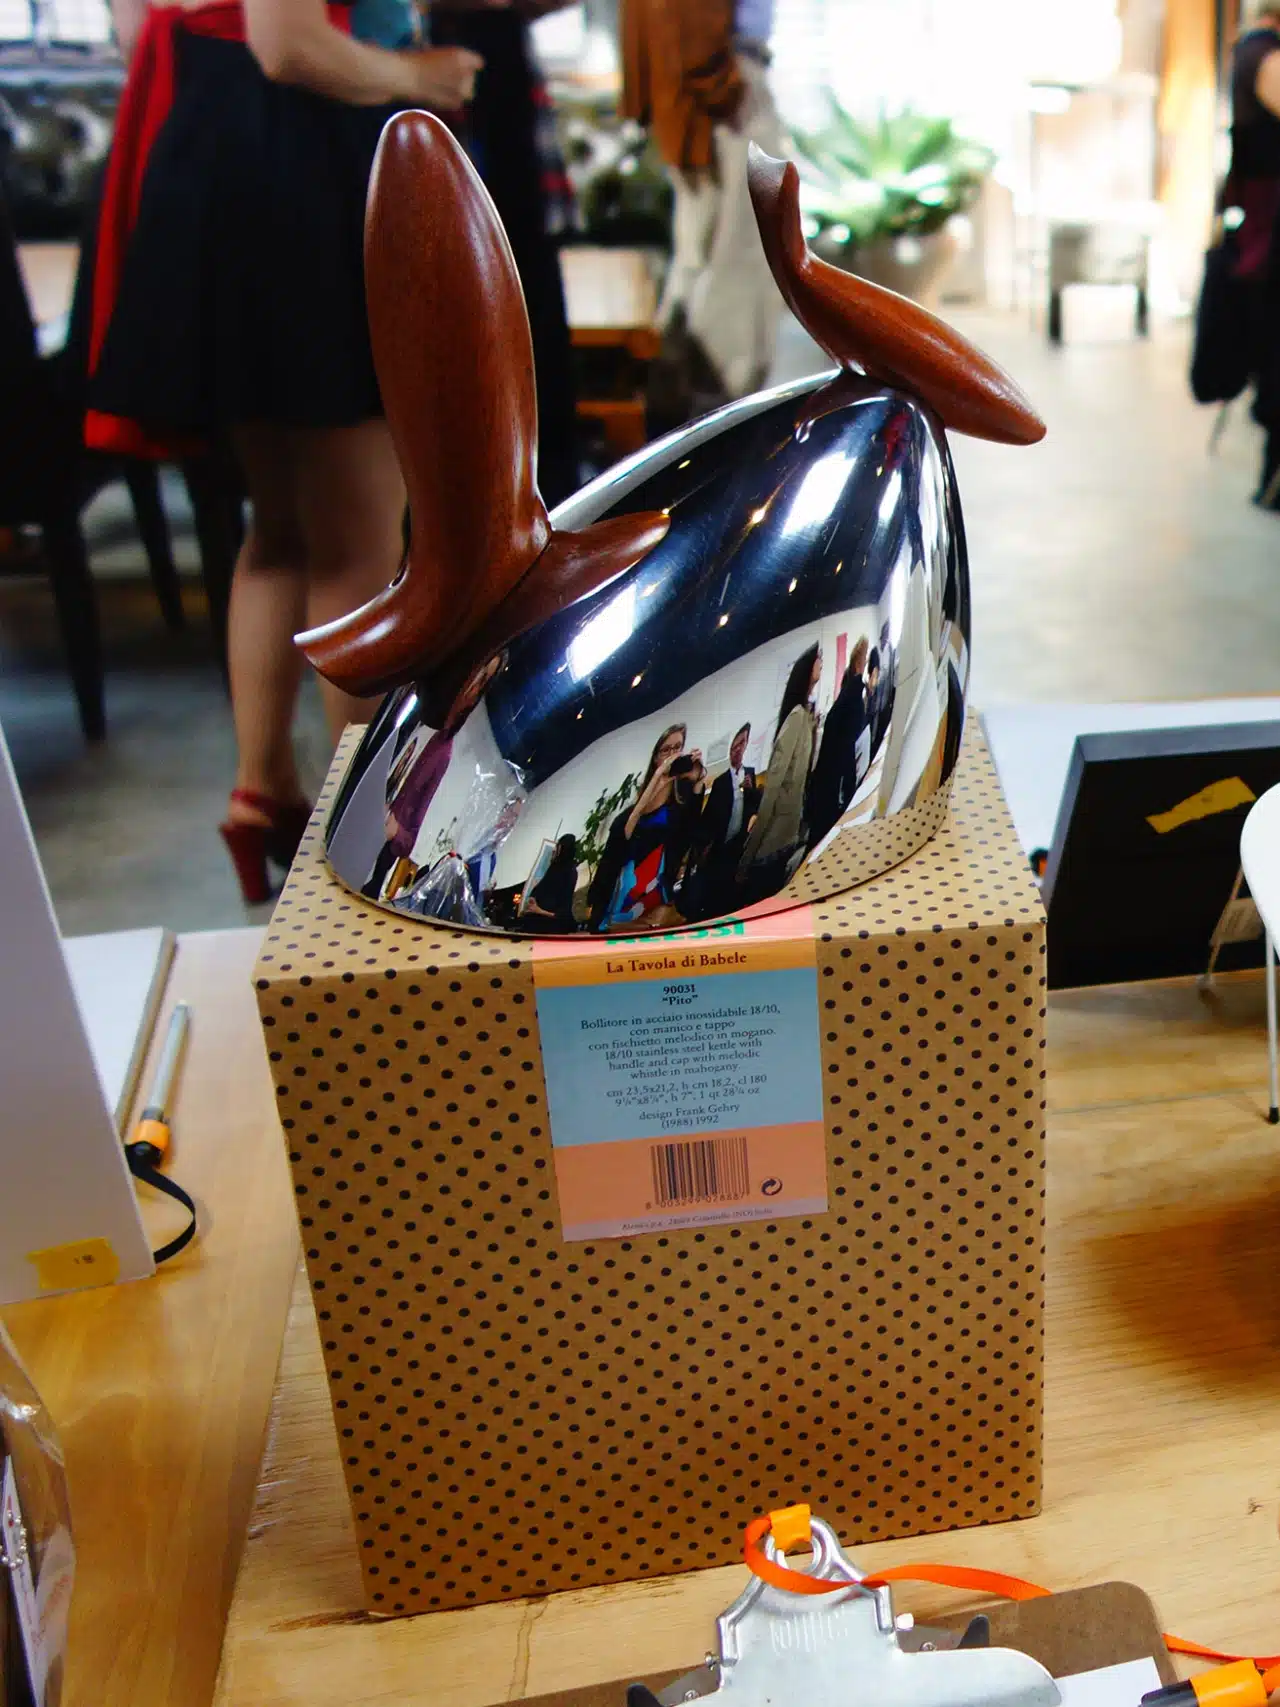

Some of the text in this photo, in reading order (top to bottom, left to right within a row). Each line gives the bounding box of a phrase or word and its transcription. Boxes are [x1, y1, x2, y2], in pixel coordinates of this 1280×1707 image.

[606, 951, 747, 973] La Tavola di Babele
[663, 983, 696, 994] 90031
[580, 1004, 781, 1030] Bollitore in acciaio inossidabile 18/10,
[629, 1028, 650, 1037] con
[653, 1024, 693, 1034] manico
[705, 1020, 736, 1032] tappo
[588, 1041, 609, 1051] con
[612, 1036, 661, 1049] fischietto
[664, 1031, 714, 1043] melodico
[717, 1029, 728, 1038] in
[605, 1040, 763, 1061] 18/10 stainless steel kettle with
[608, 1050, 761, 1071] handle and cap with melodic
[629, 1068, 668, 1080] whistle
[670, 1068, 681, 1077] in
[606, 1090, 623, 1098] cm
[681, 1081, 689, 1091] h
[692, 1081, 708, 1089] cm
[750, 1074, 768, 1084] 180
[747, 1087, 760, 1095] oz
[639, 1103, 740, 1121] design Frank Gehry
[696, 1114, 719, 1125] 1992
